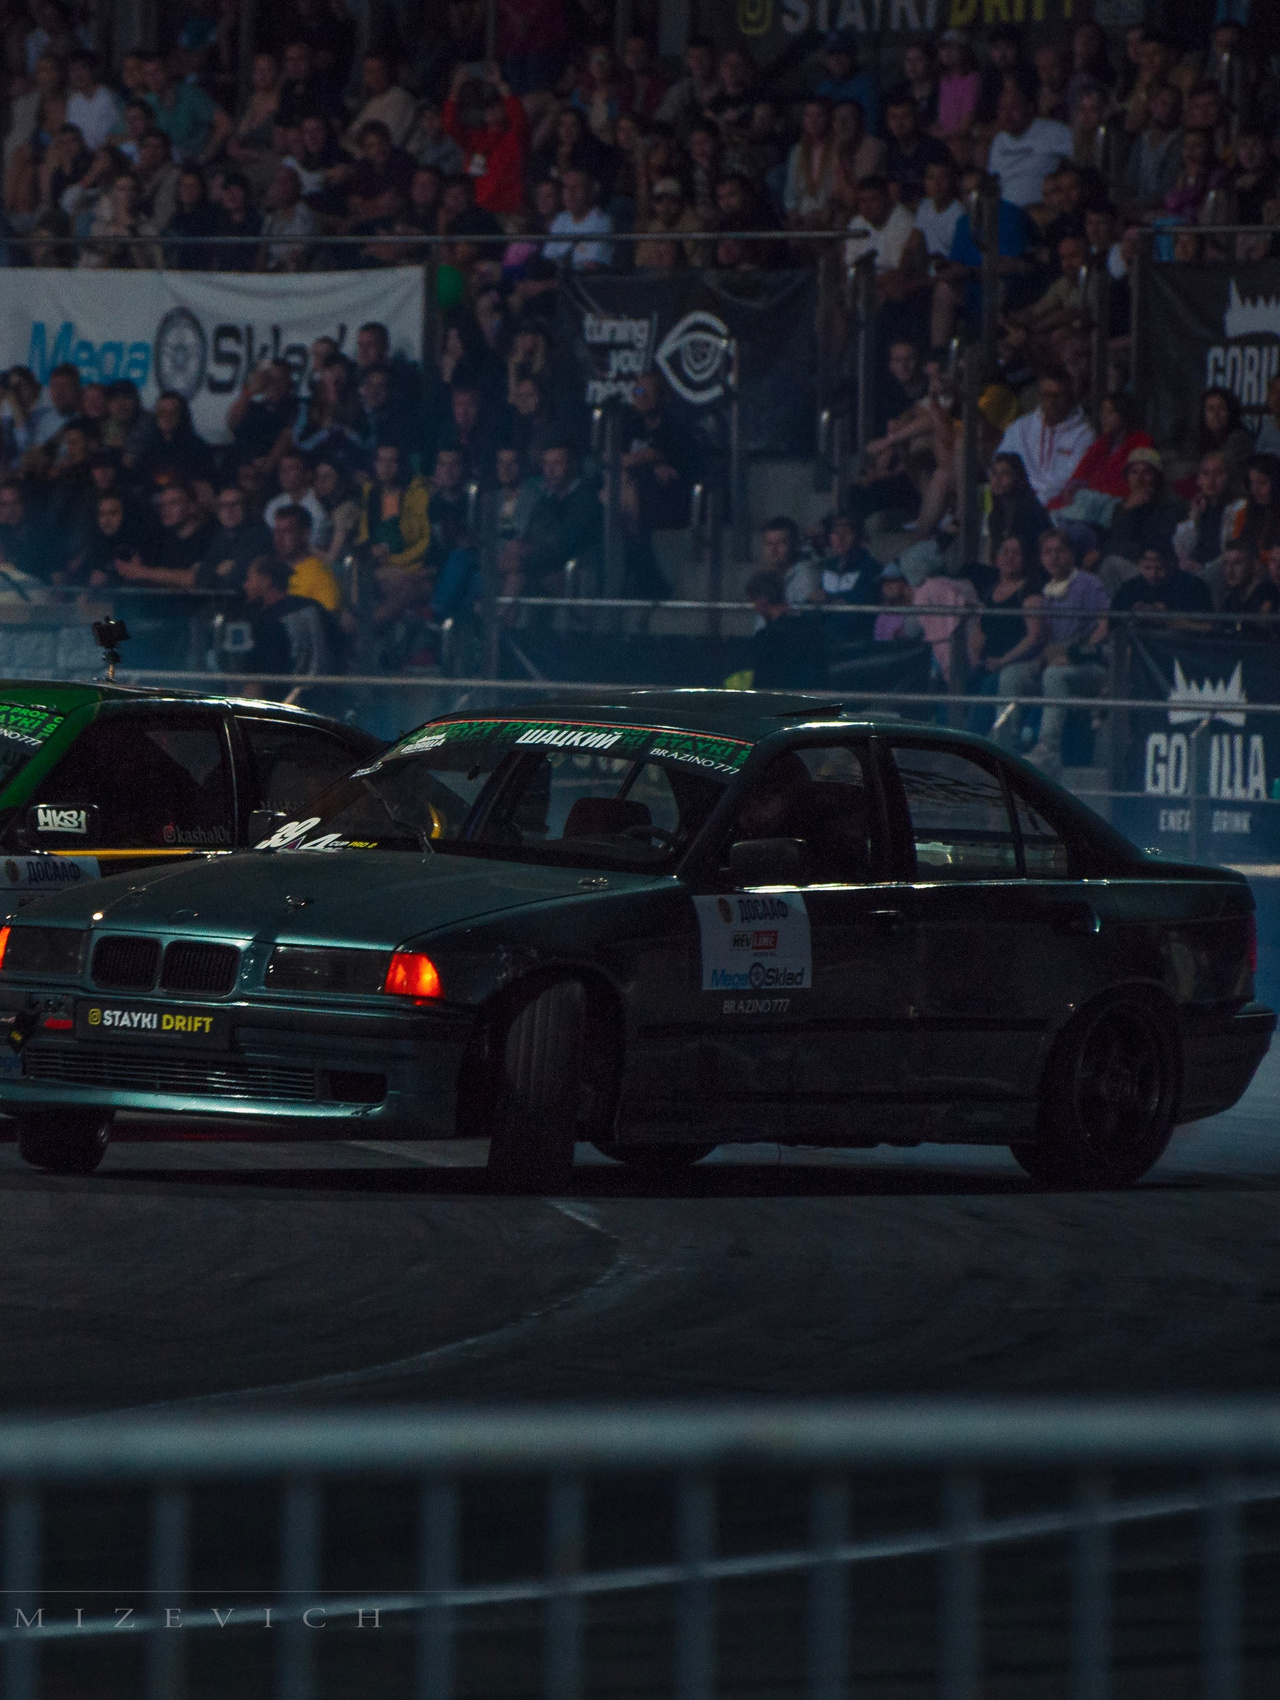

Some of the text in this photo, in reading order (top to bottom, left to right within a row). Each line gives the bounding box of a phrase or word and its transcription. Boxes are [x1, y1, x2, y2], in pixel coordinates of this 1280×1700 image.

[515, 729, 623, 750] ШАЦКИЙ
[1144, 732, 1268, 801] GOILLA
[27, 861, 80, 884] ДОСААФ
[738, 899, 789, 923] ДОСААФ
[103, 1009, 214, 1034] STAYKI DRIFT
